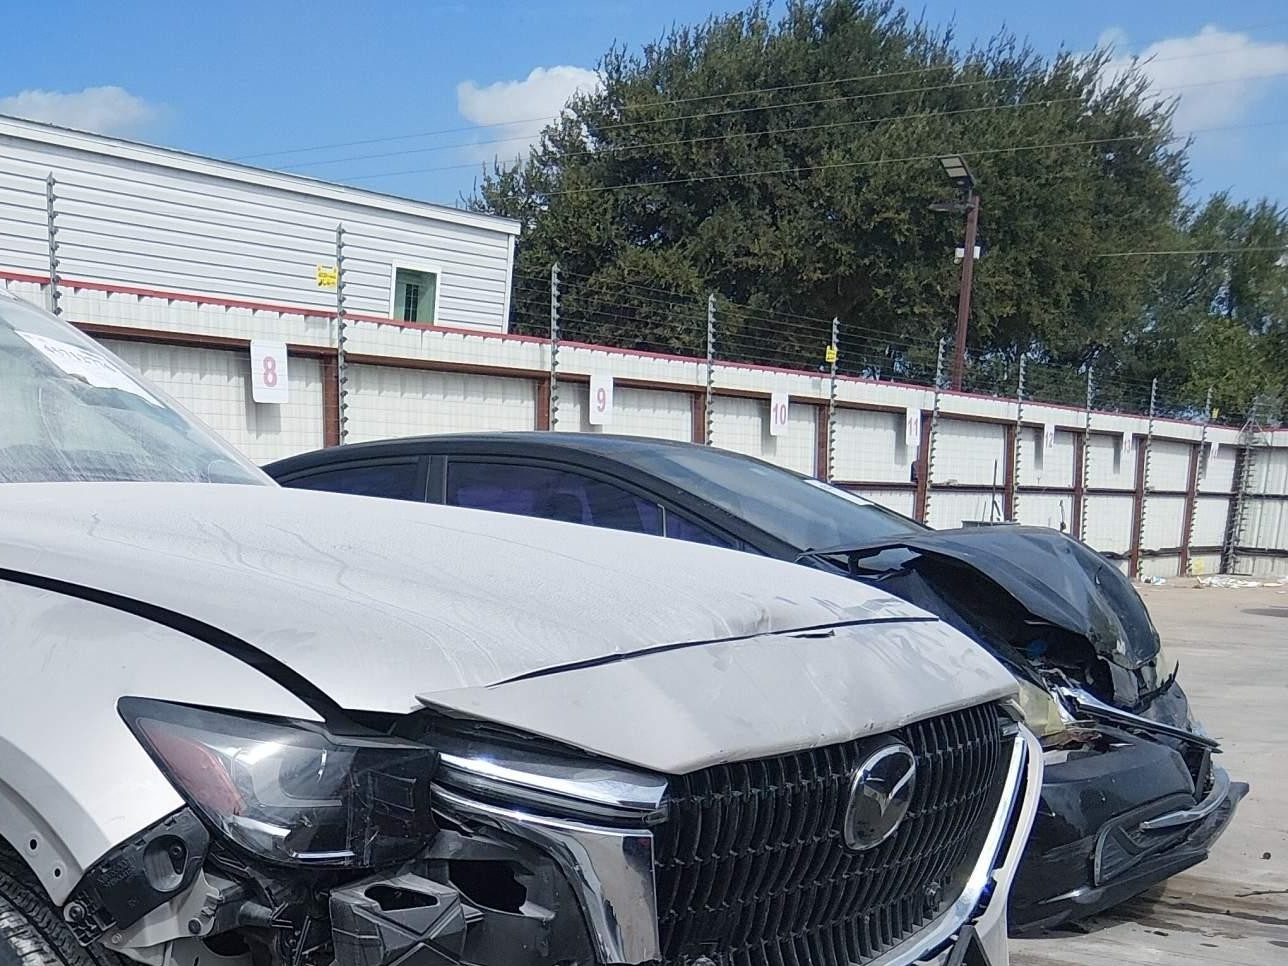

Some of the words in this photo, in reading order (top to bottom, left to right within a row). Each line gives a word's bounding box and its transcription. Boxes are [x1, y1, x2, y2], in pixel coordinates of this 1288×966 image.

[262, 356, 278, 388] 8
[596, 387, 606, 413] 9
[772, 403, 787, 425] 10
[907, 416, 918, 437] 11
